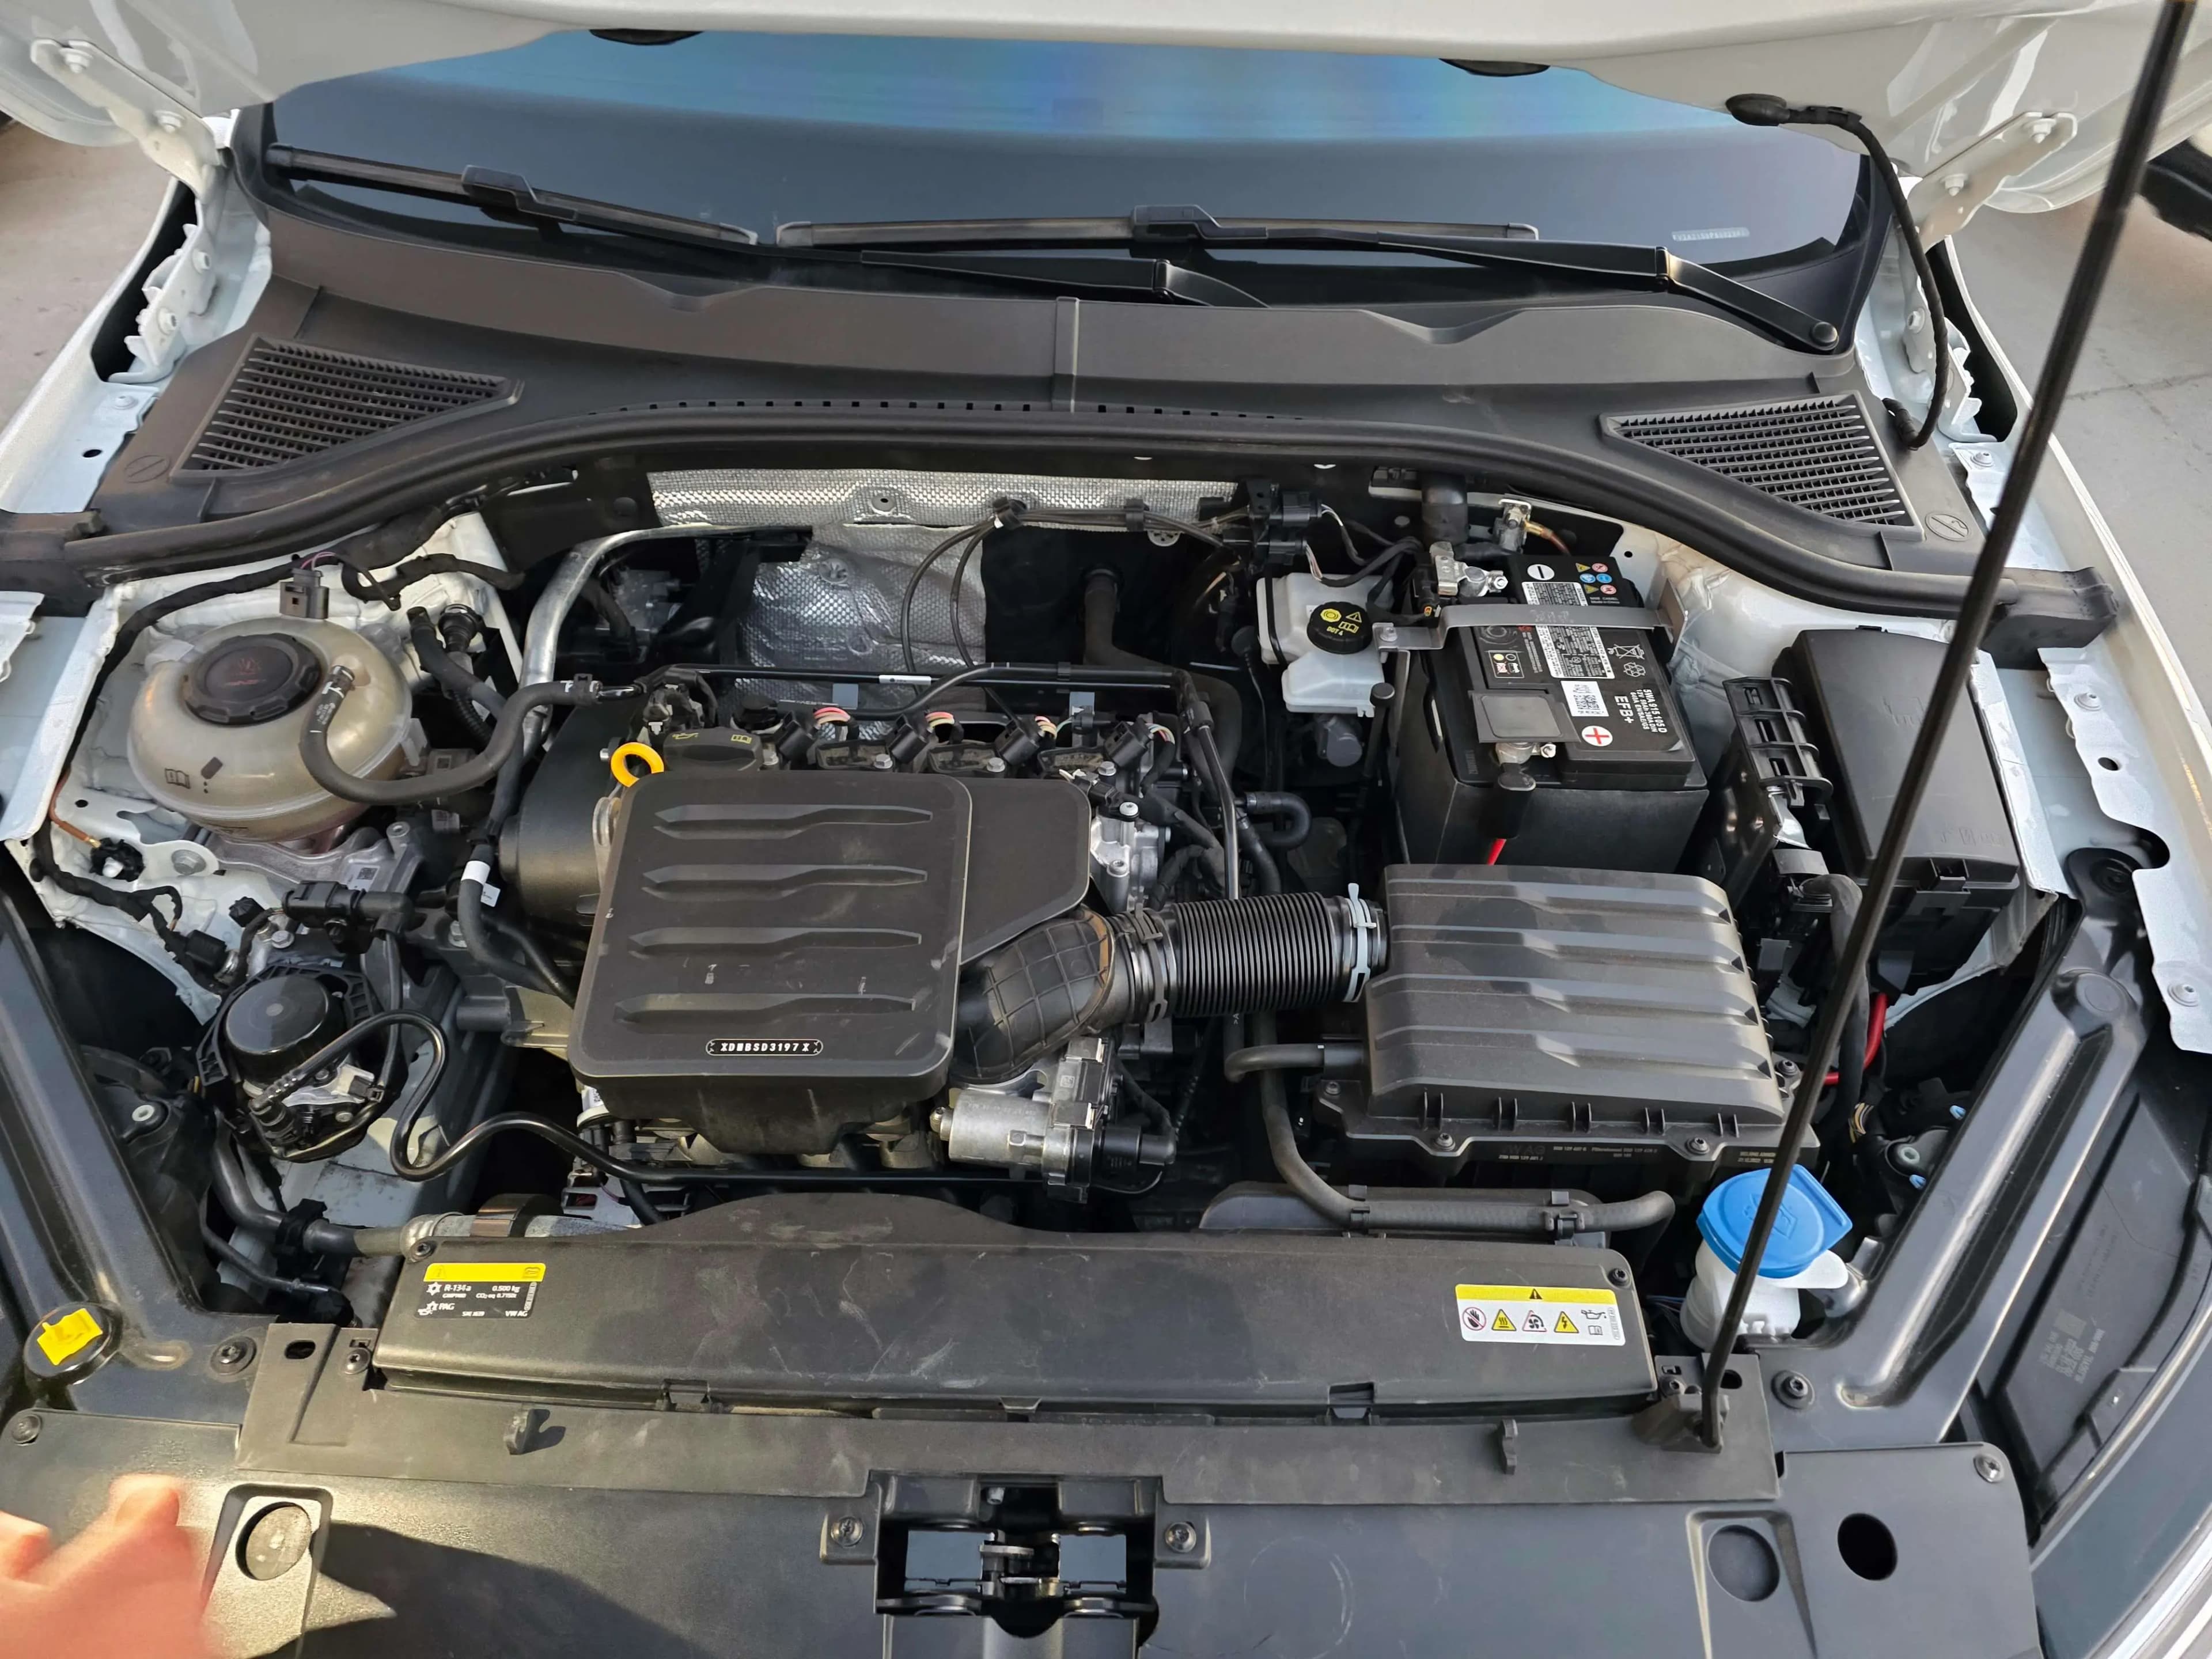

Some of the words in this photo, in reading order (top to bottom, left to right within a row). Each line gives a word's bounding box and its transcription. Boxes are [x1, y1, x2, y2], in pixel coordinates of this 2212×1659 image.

[1327, 626, 1340, 634] DOT
[1643, 689, 1656, 703] 5WA
[1614, 695, 1634, 724] EFB+
[1636, 689, 1645, 698] 12V
[1649, 723, 1658, 733] DIN
[1648, 703, 1661, 715] 915
[1653, 715, 1666, 727] 105
[511, 1285, 521, 1293] kg
[438, 1302, 456, 1310] PAG
